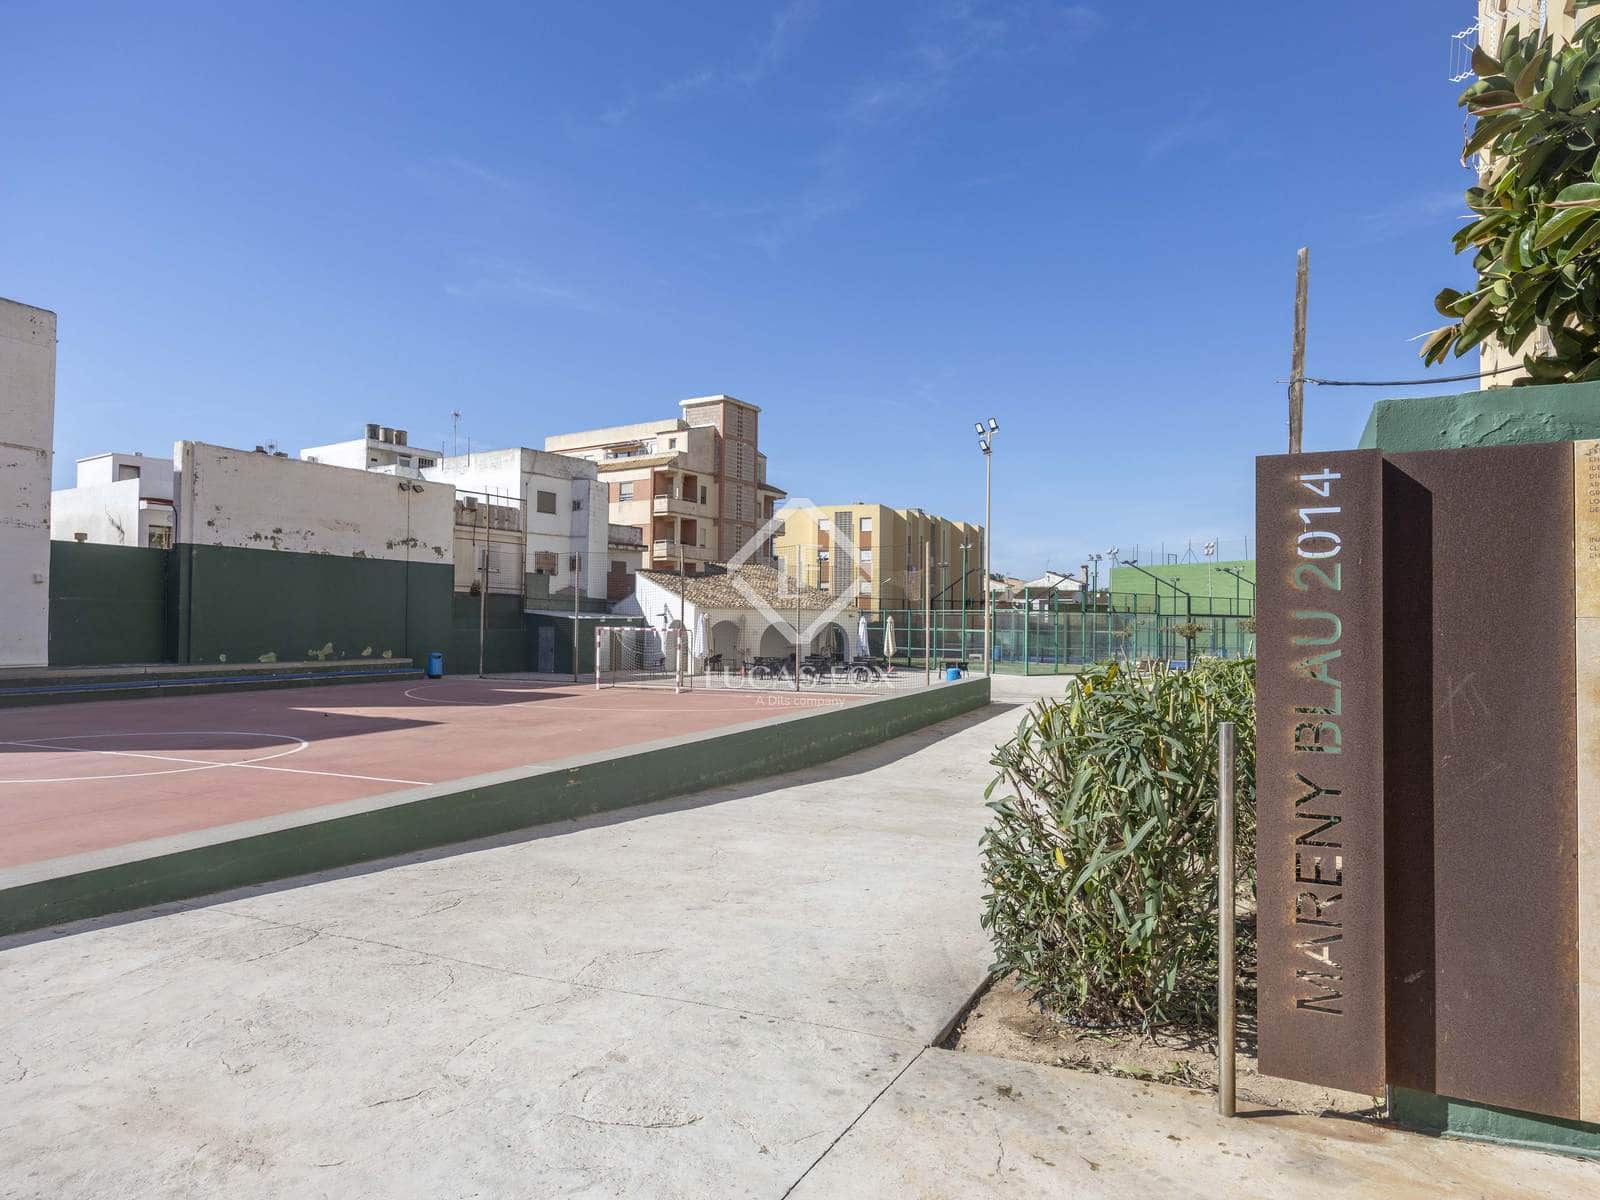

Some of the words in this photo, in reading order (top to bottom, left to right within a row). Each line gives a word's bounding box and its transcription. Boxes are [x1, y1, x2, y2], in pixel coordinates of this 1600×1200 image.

[1294, 468, 1342, 591] 2014
[1294, 610, 1342, 754] BLAU
[1295, 772, 1343, 1015] MARENY
